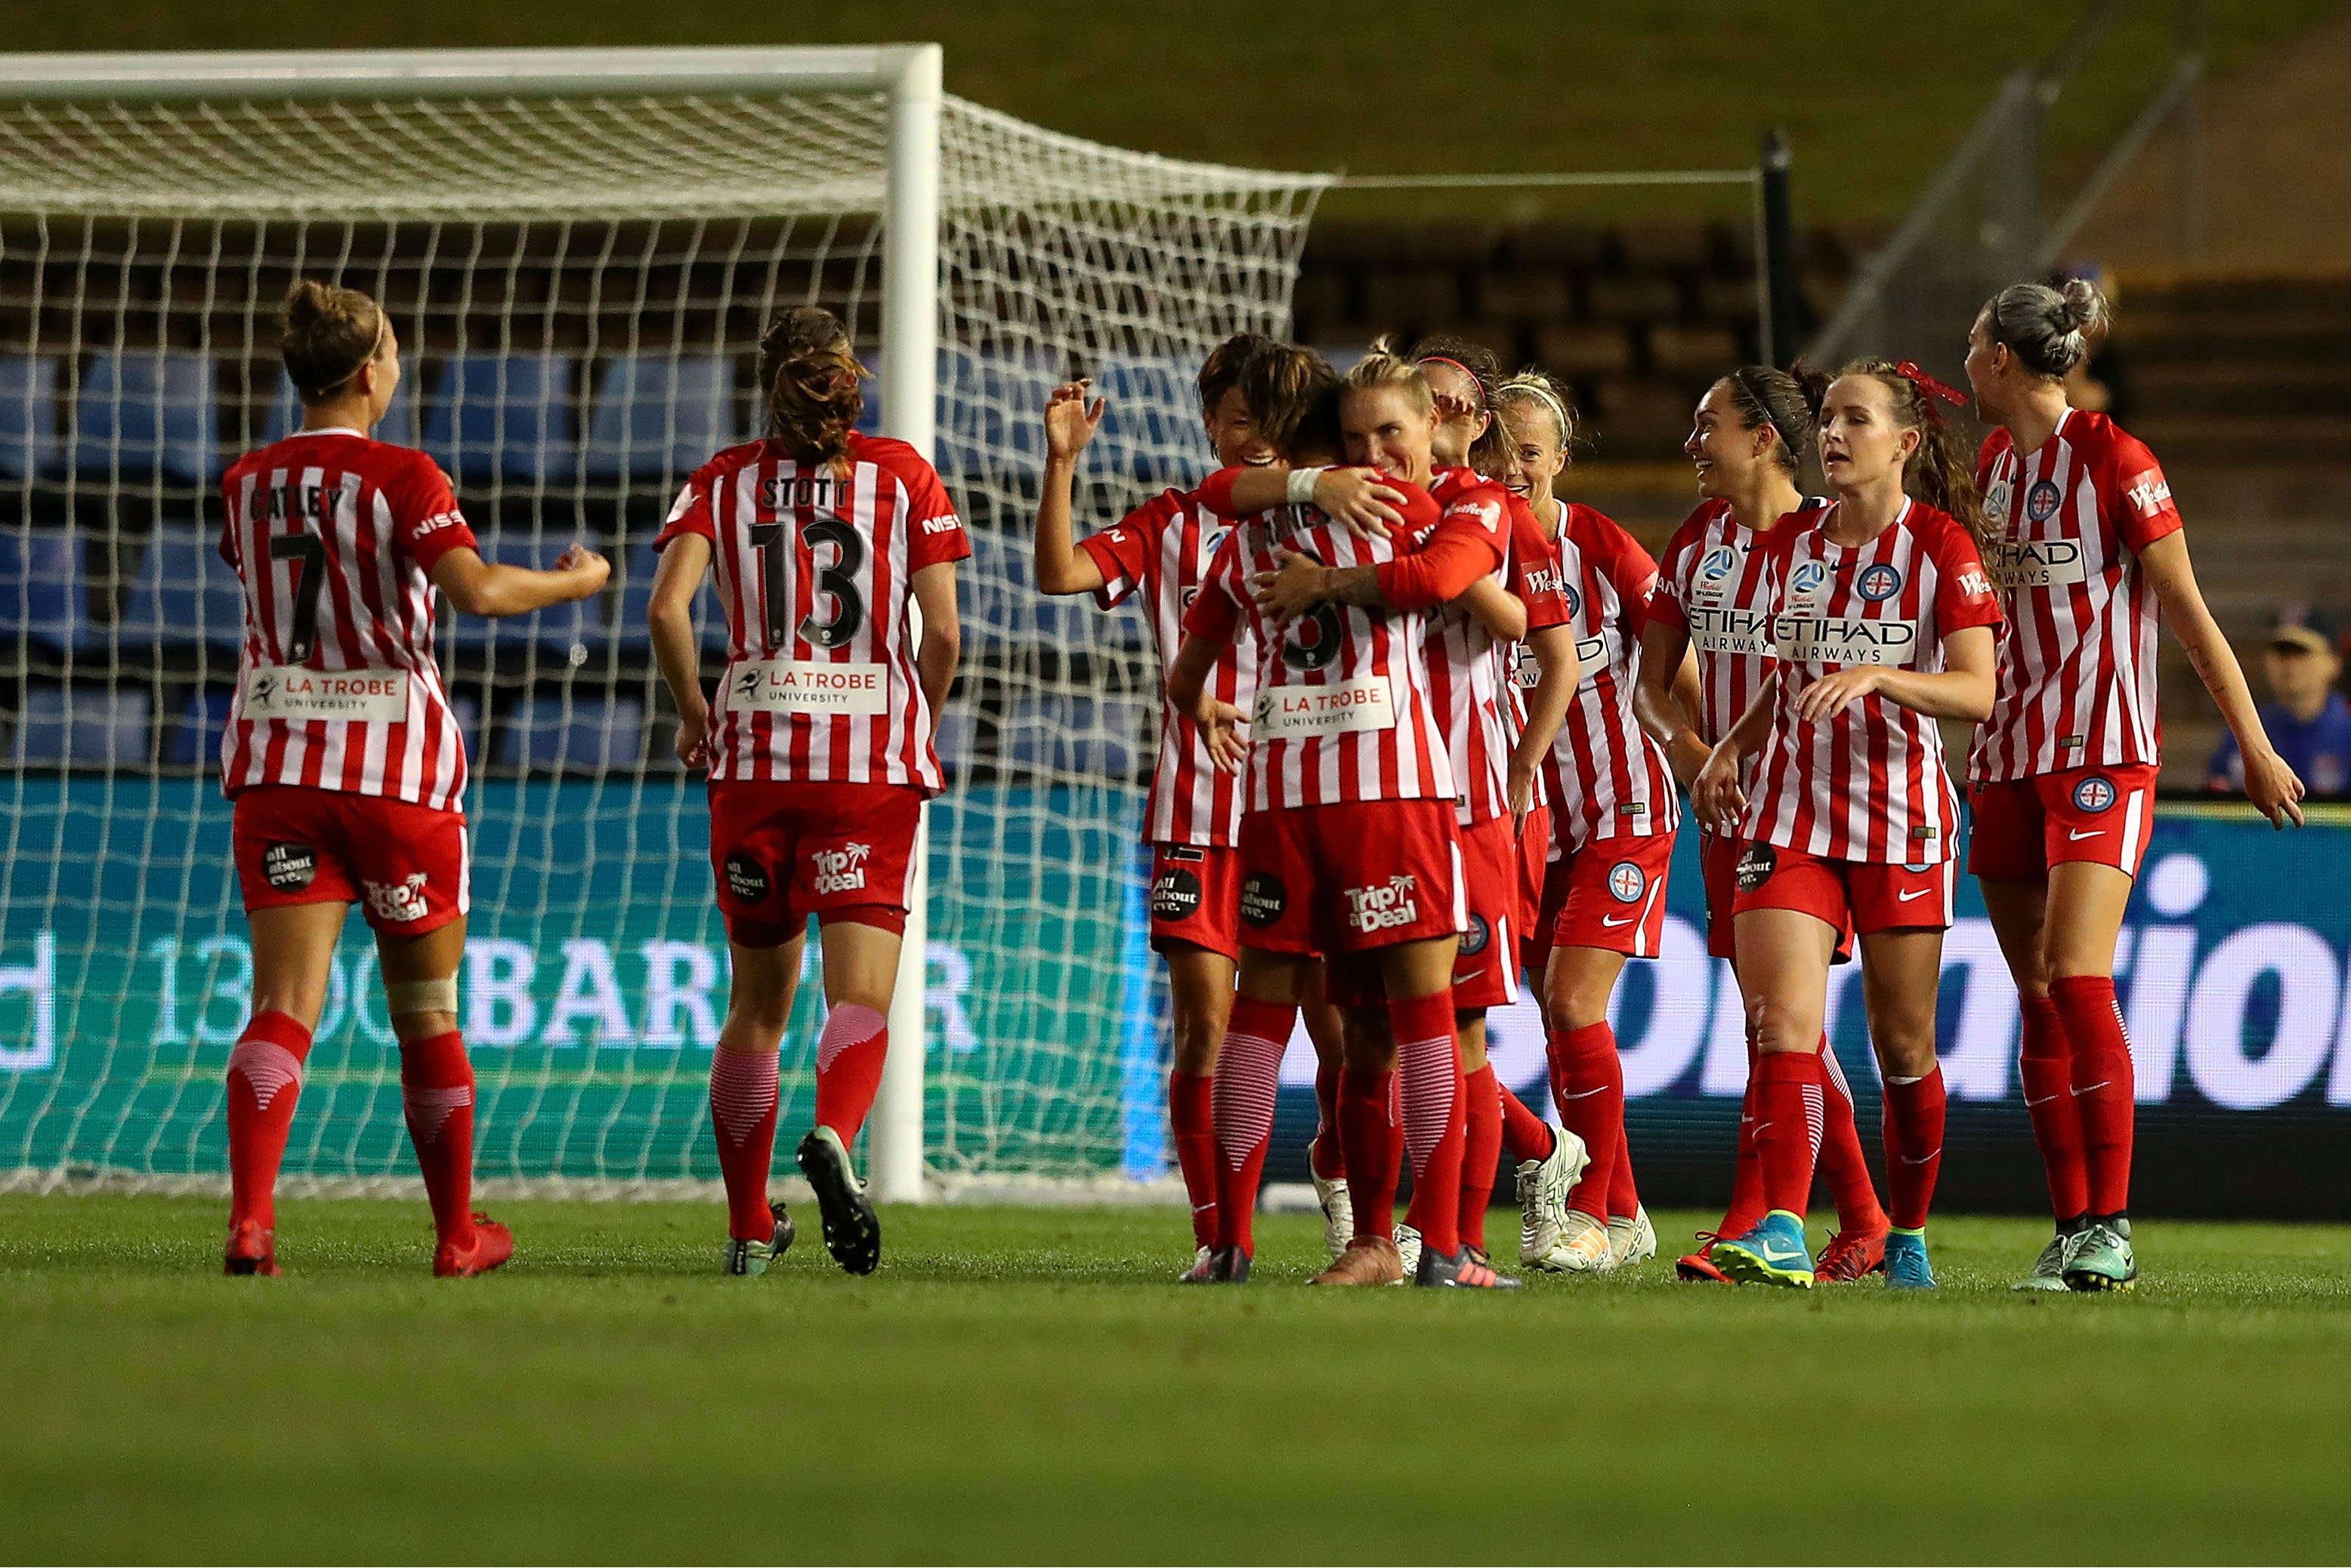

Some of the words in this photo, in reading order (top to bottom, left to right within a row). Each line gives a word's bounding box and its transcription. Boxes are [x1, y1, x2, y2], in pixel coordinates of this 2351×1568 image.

[250, 486, 343, 521] CATLEY
[762, 477, 850, 508] STOTT
[749, 519, 864, 650] 13
[270, 532, 326, 665] 7
[1776, 619, 1913, 645] ETIHAD
[1702, 637, 1777, 653] AIRWAY
[1792, 647, 1880, 662] AIRWAYS
[286, 678, 313, 694] LA
[321, 679, 397, 696] TROBE
[770, 671, 797, 687] LA
[804, 672, 876, 690] TROBE
[284, 699, 367, 710] UNIVERSITY
[769, 692, 848, 703] UNIVERSITY
[1284, 697, 1310, 712] LA
[1318, 688, 1382, 710] TROBE
[267, 847, 286, 862] all
[811, 850, 848, 875] Trip
[1344, 885, 1396, 912] Trip
[1360, 899, 1417, 934] Deal
